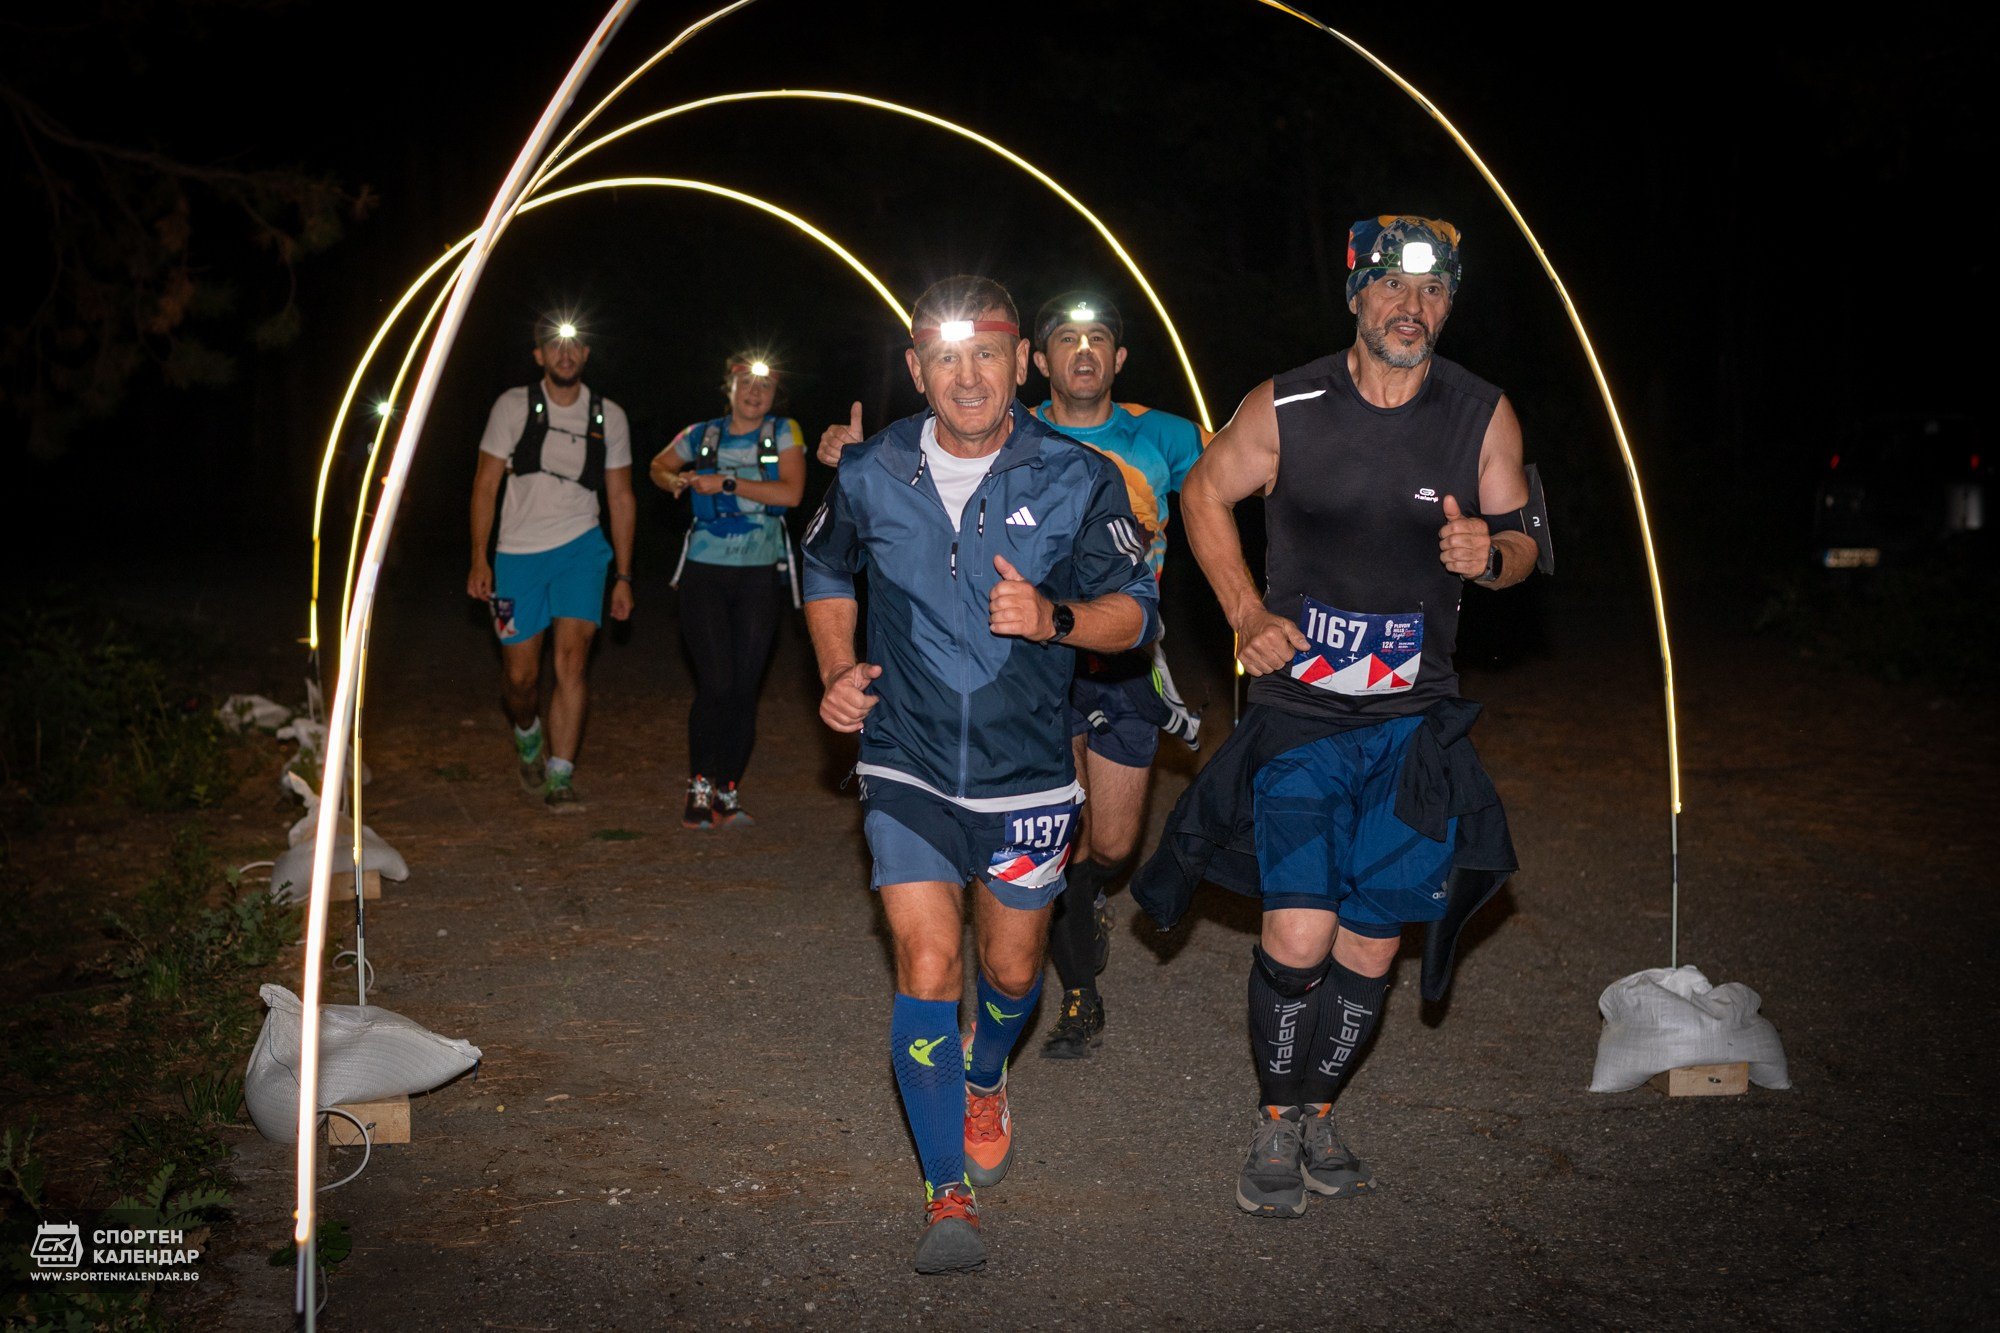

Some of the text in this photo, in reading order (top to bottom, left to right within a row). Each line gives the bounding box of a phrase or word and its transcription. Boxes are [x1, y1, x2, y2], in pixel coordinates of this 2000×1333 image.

[1306, 607, 1368, 653] 1167
[1382, 641, 1394, 649] 12K
[1012, 813, 1071, 848] 1137
[1268, 1001, 1307, 1074] Kalenji
[1318, 995, 1373, 1077] Kalenji
